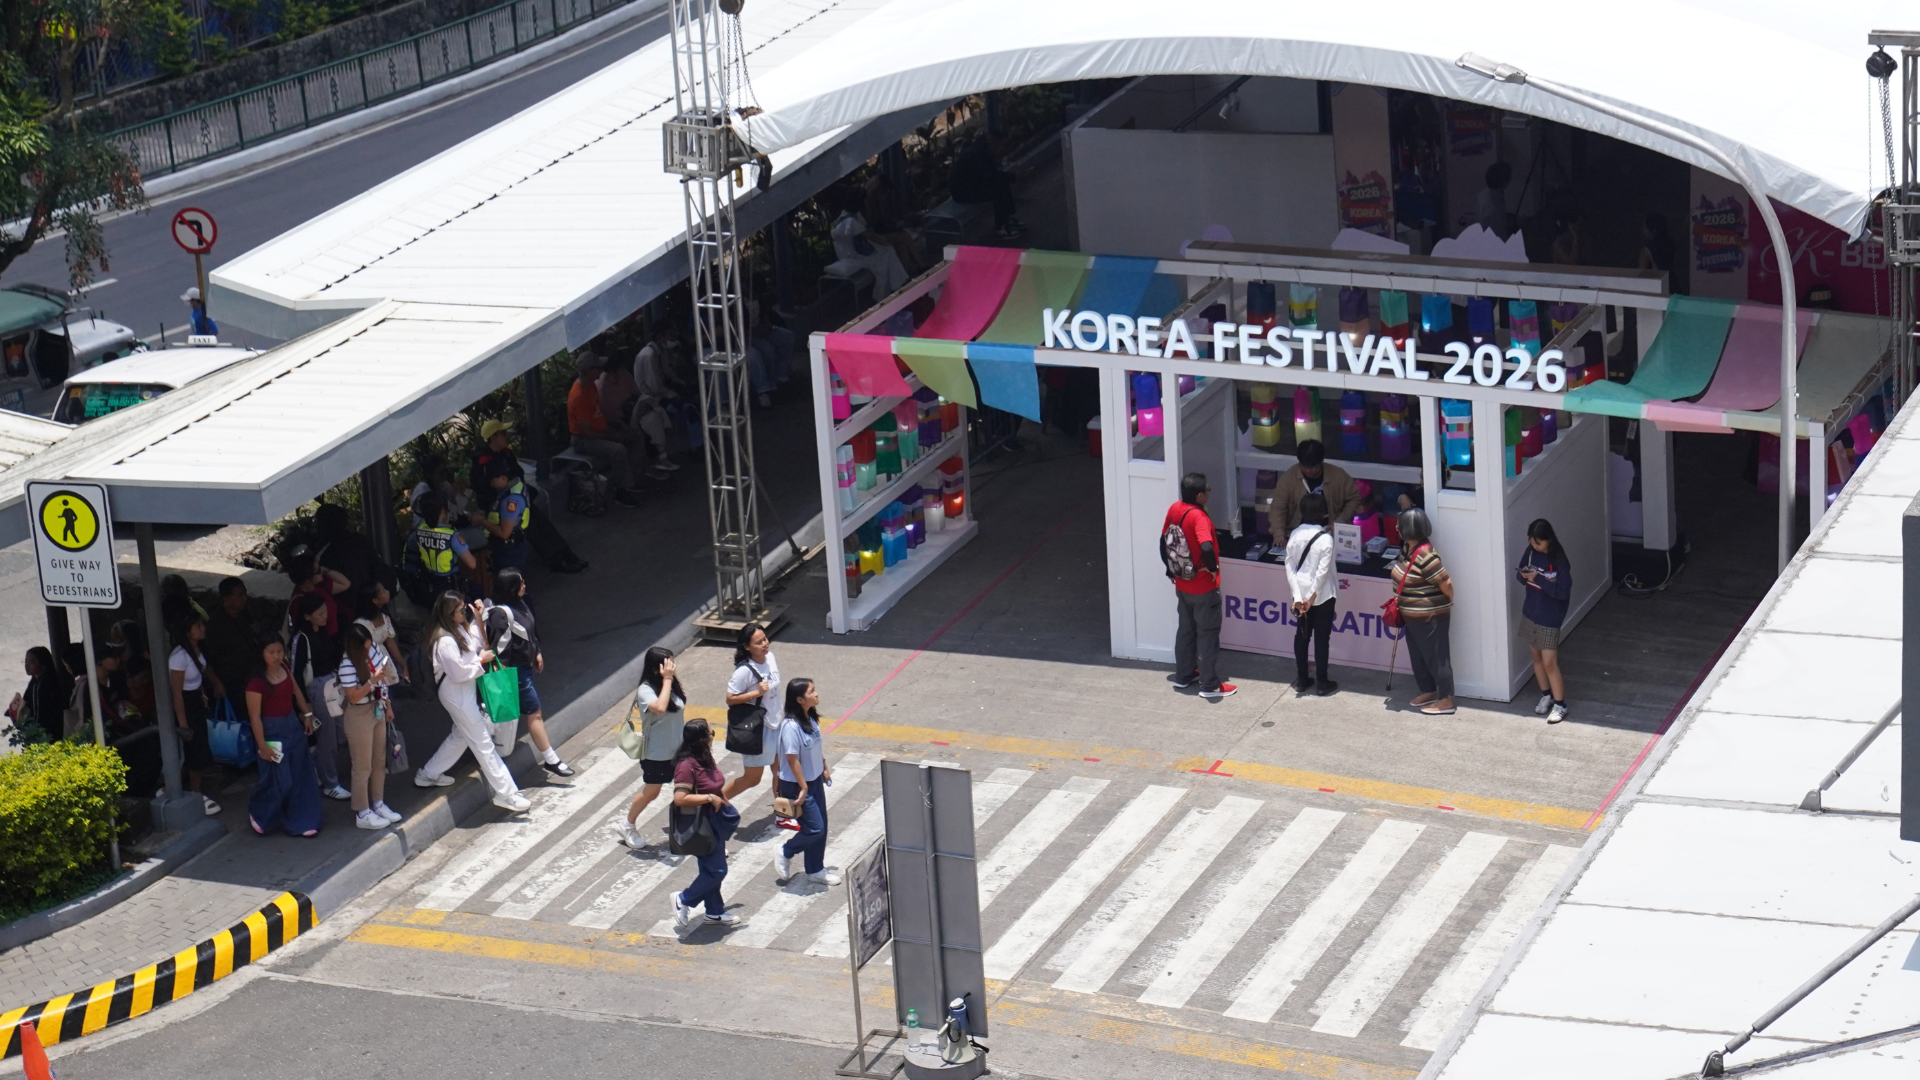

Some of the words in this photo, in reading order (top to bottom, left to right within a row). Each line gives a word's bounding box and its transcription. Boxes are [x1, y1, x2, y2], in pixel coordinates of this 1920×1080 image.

[1350, 186, 1380, 200] 2026
[1350, 208, 1382, 218] KOREA
[1704, 213, 1736, 226] 2026
[1702, 234, 1736, 245] KOREA
[1702, 250, 1738, 266] FESTIVAL
[1043, 308, 1199, 360] KOREA
[1213, 322, 1429, 380] FESTIVAL
[1444, 341, 1566, 392] 2026
[419, 536, 446, 550] PULIS
[51, 558, 75, 570] GIVE
[79, 560, 101, 570] WAY
[71, 572, 84, 582] TO
[46, 585, 113, 598] PEDESTRIANS
